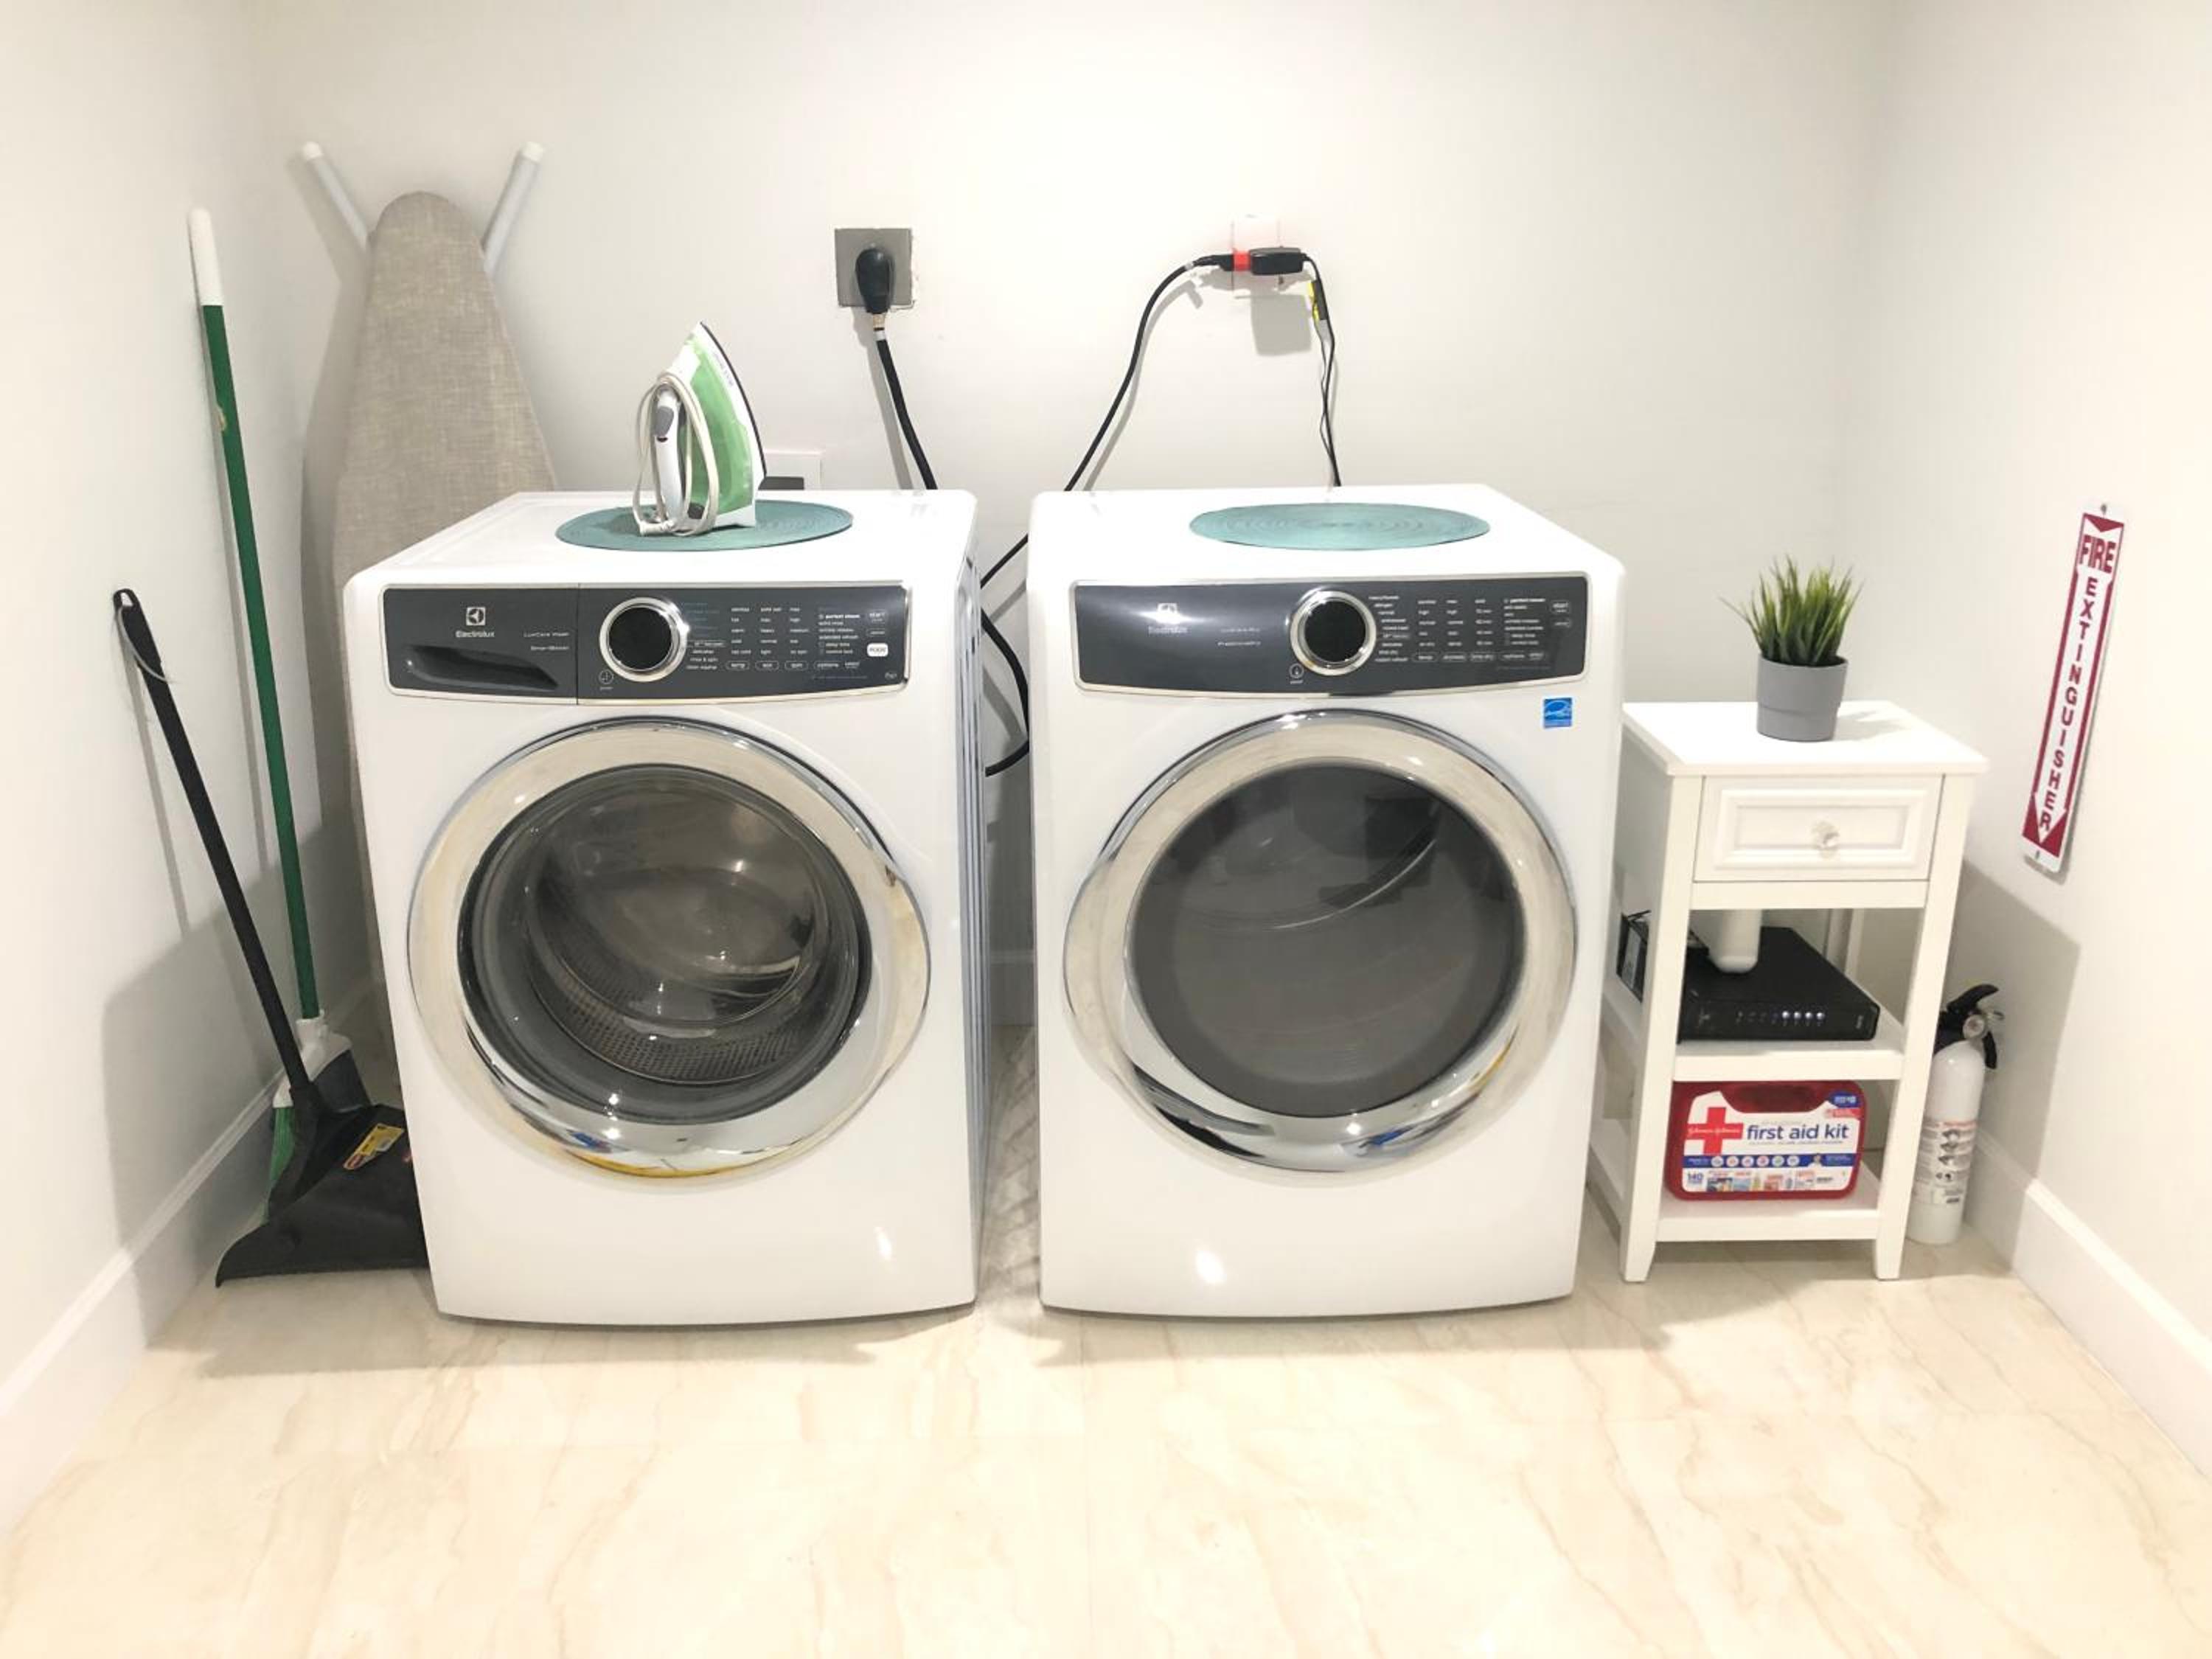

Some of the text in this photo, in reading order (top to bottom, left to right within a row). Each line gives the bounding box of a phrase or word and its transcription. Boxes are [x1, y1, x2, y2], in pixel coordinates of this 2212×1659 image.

[2079, 535, 2117, 574] FIRE
[2039, 576, 2098, 831] EXTINGUISHER
[1747, 1124, 1850, 1140] first aid kit
